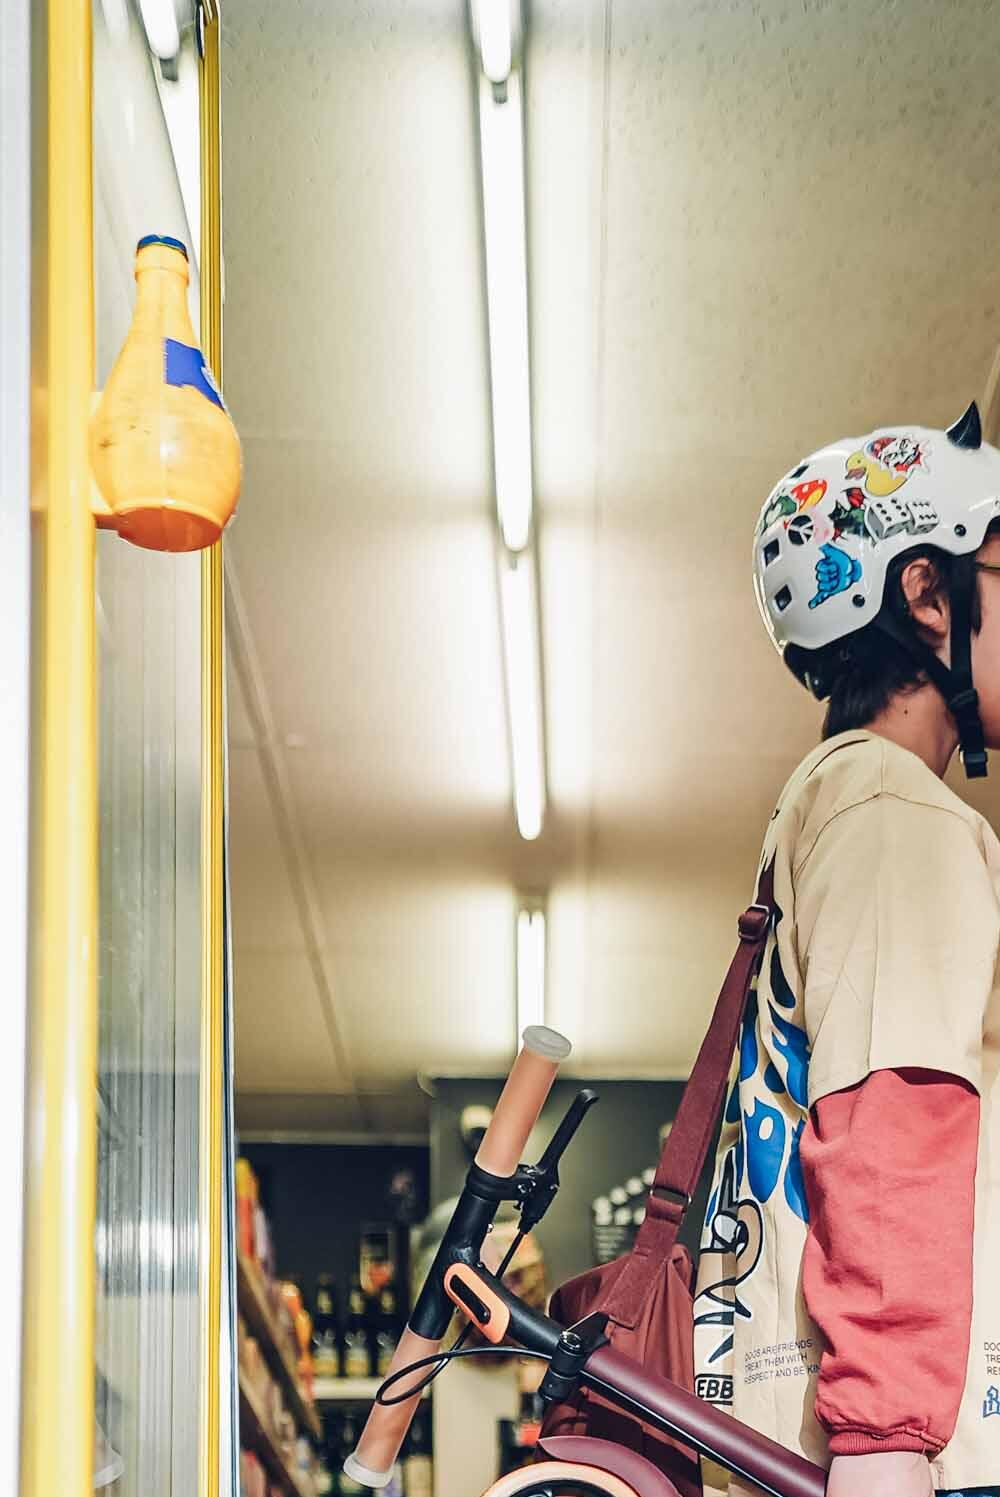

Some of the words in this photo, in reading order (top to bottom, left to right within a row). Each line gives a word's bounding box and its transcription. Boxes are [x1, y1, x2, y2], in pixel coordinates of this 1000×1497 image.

[764, 1356, 785, 1368] THEM
[785, 1351, 808, 1364] WITH
[775, 1368, 792, 1378] AND
[793, 1366, 805, 1377] BE
